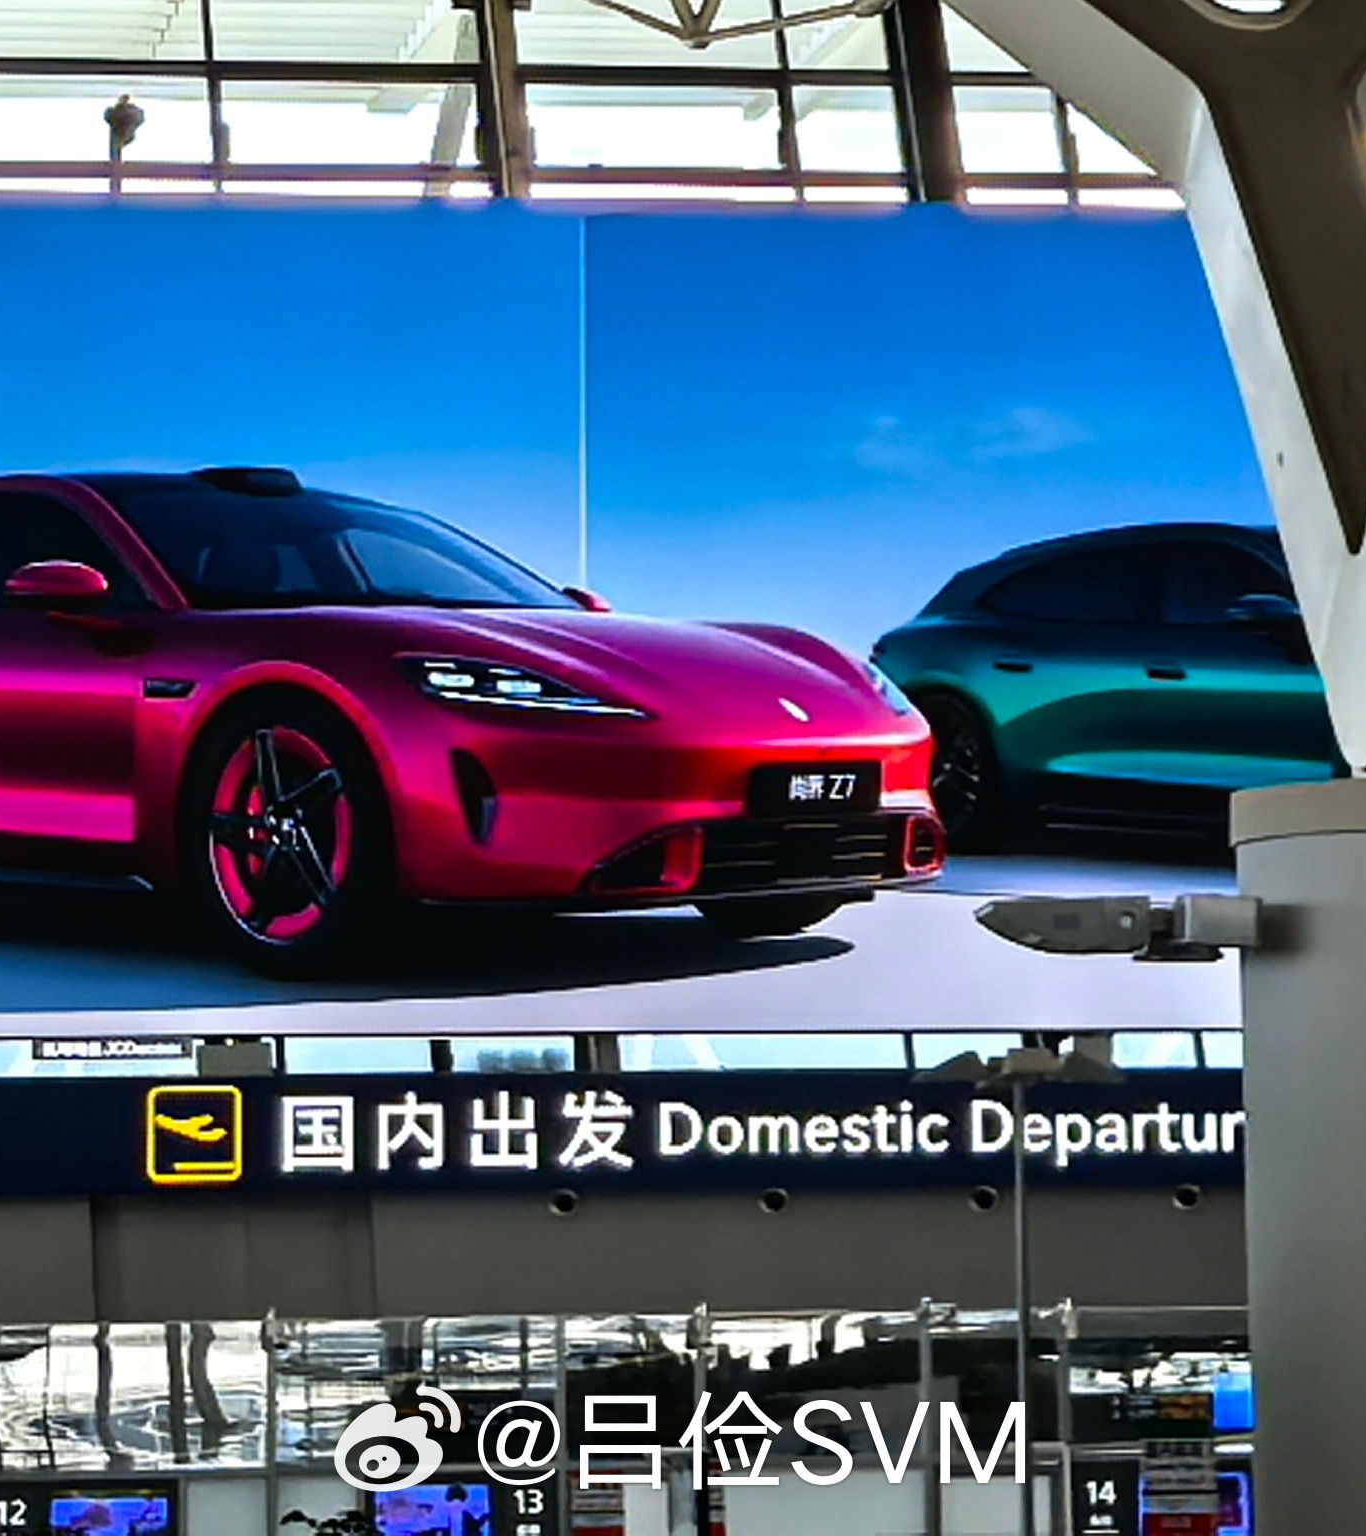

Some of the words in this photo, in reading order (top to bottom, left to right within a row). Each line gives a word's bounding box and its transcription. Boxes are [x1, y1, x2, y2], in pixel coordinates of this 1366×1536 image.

[828, 774, 857, 800] Z7
[280, 1090, 635, 1172] 国内出发
[657, 1099, 951, 1156] Domestic
[513, 1489, 545, 1515] 13
[1086, 1480, 1117, 1505] 14
